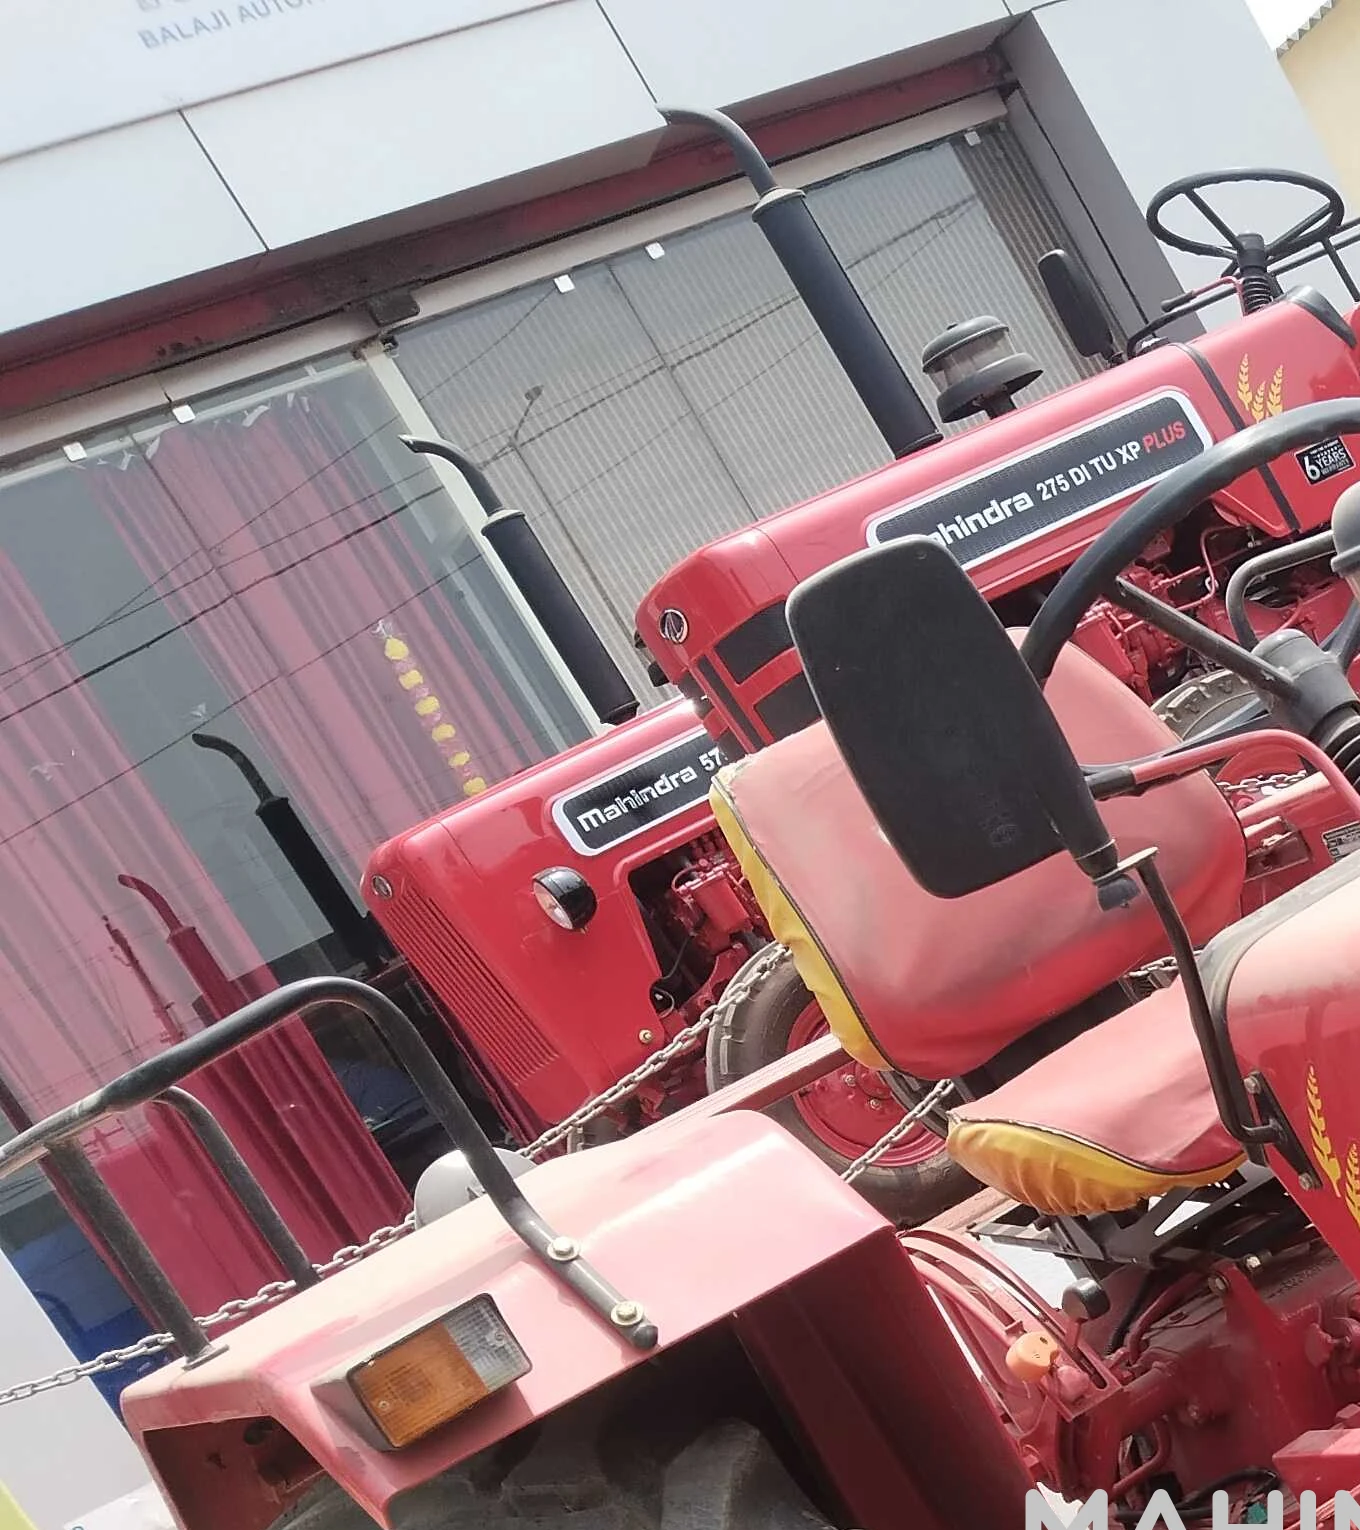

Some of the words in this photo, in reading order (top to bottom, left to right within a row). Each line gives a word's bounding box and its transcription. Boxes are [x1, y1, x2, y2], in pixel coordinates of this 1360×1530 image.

[138, 9, 232, 49] BALAJI
[238, 0, 320, 22] AUTO
[927, 490, 1034, 547] hindra
[1036, 473, 1071, 501] 275
[1071, 465, 1093, 487] DI
[1088, 453, 1118, 479] TU
[1111, 440, 1142, 466] XP
[1142, 419, 1187, 454] PLUS
[1303, 456, 1321, 480] 6
[1315, 447, 1347, 469] YEARS
[577, 765, 699, 832] Mahindra
[699, 746, 729, 772] 57
